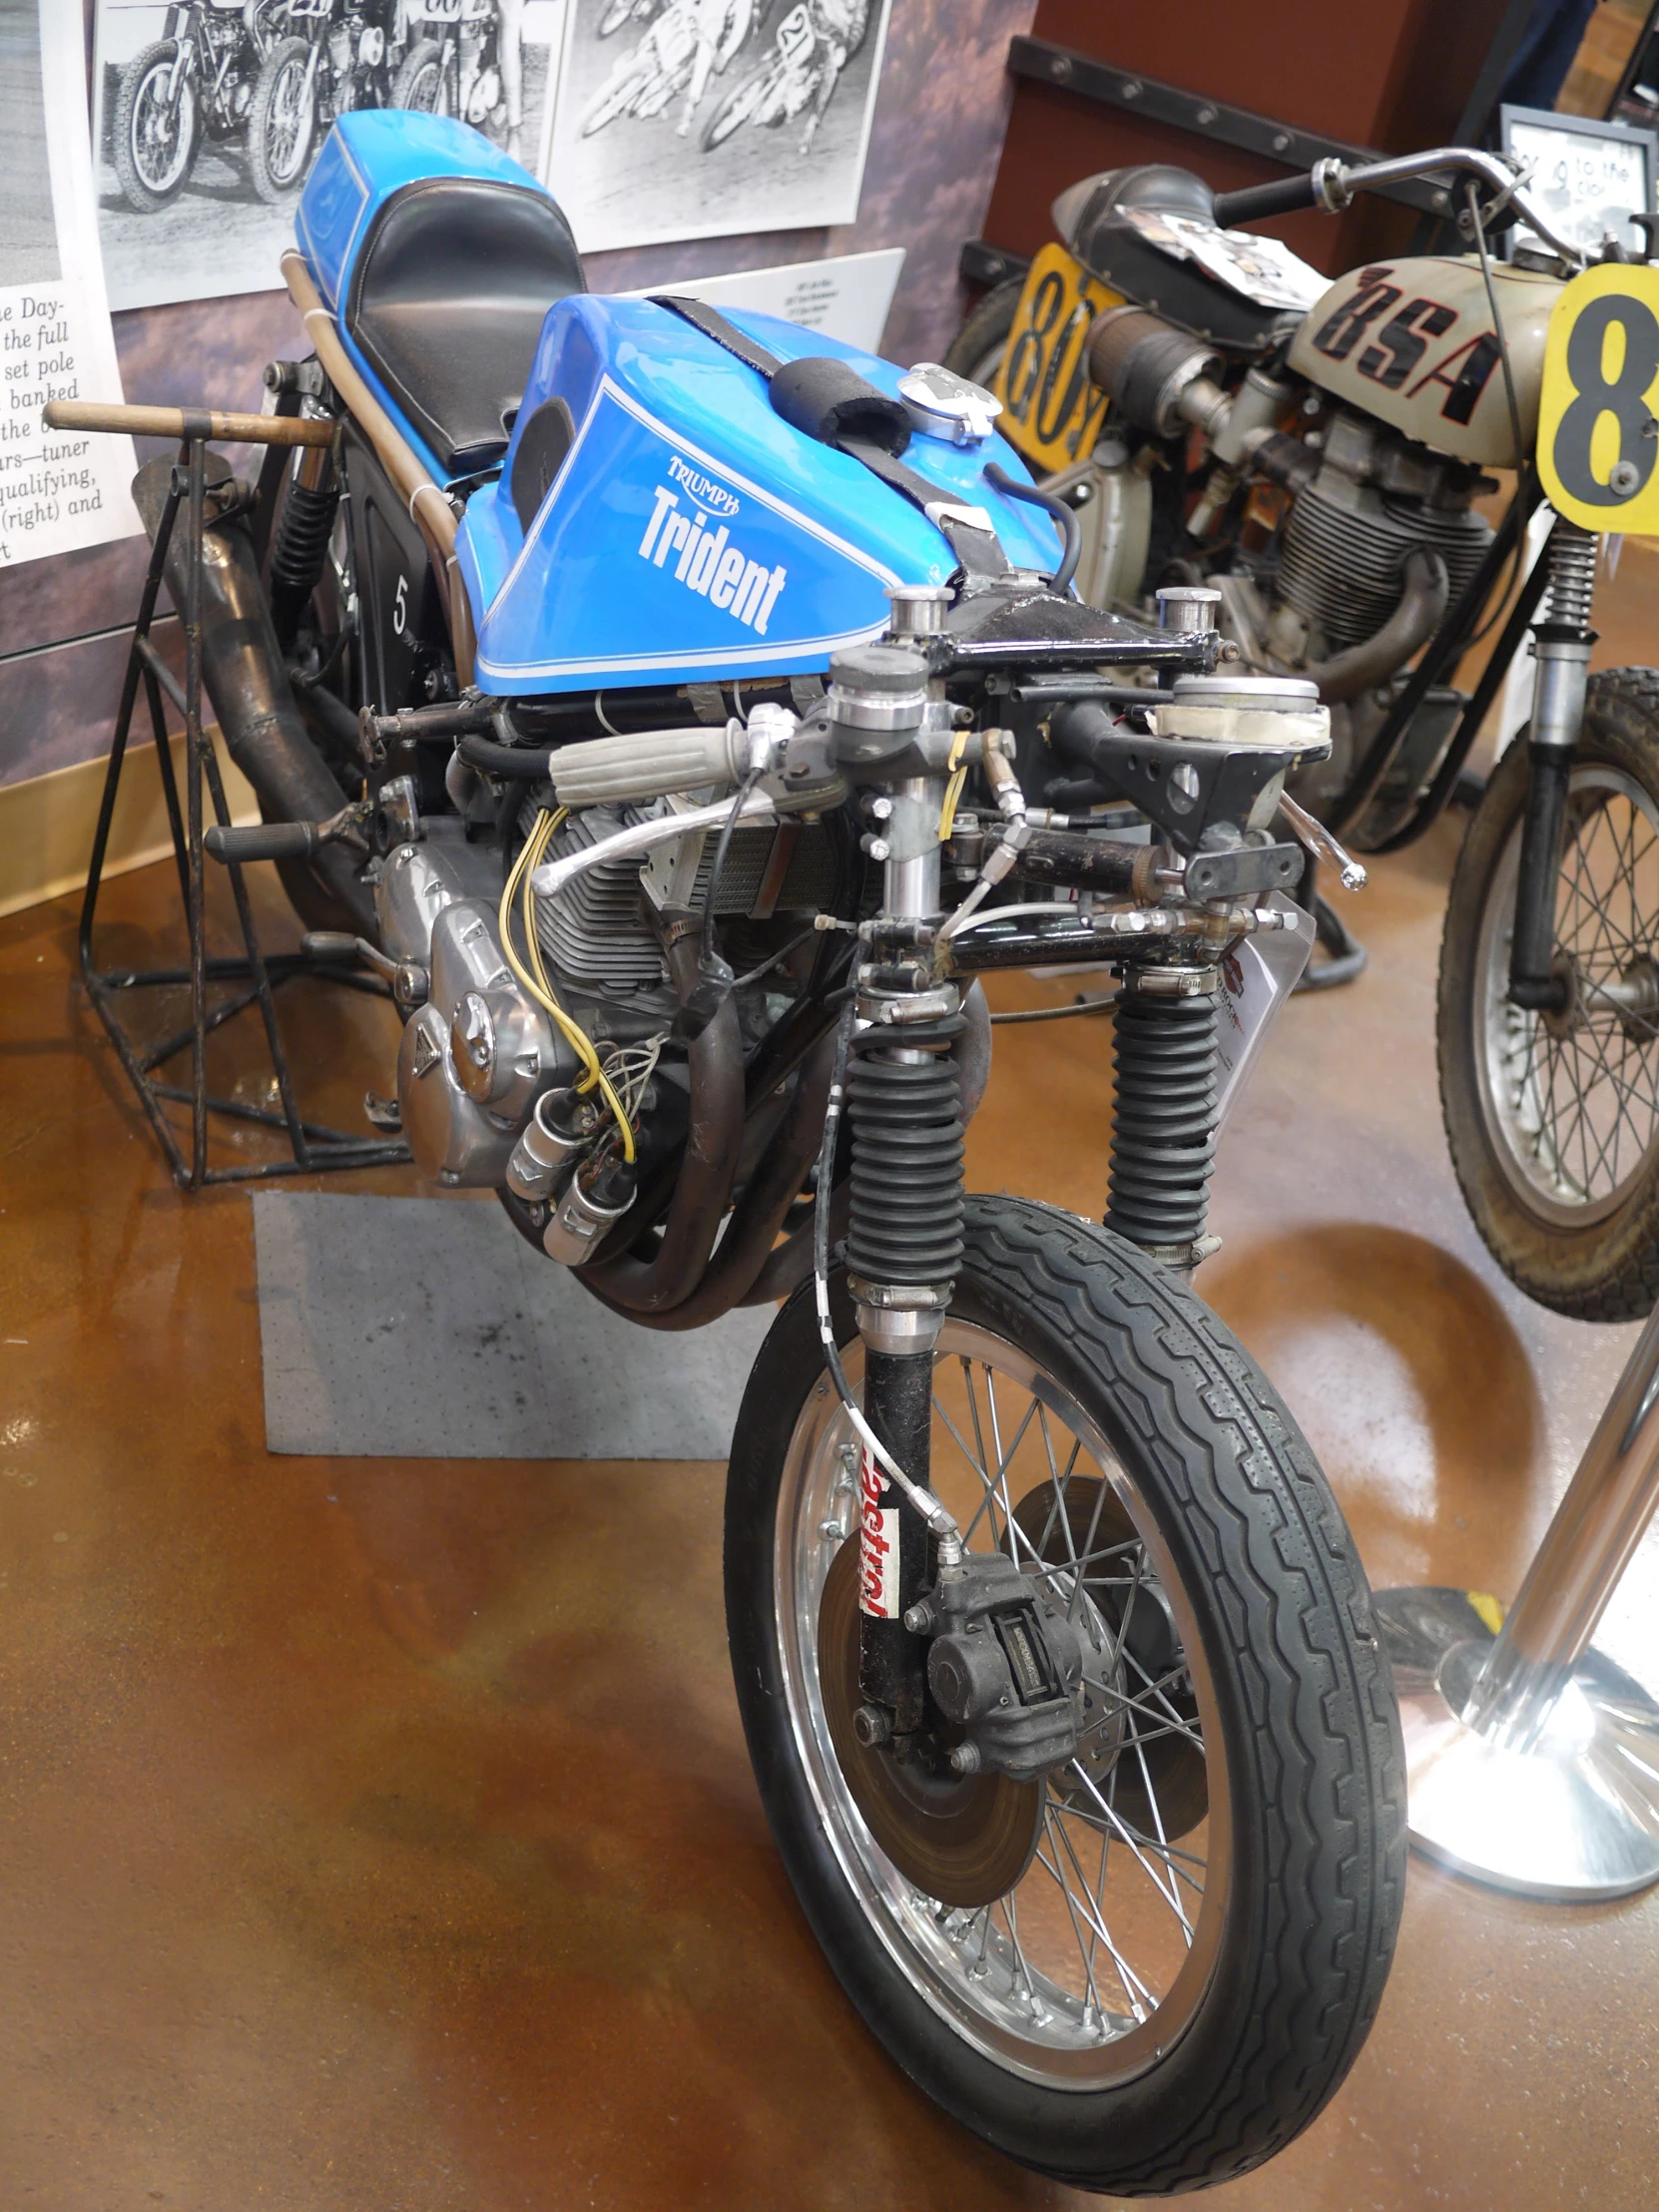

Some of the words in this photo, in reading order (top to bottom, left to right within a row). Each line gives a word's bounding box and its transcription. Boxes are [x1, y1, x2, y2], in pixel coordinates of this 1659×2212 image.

[21, 296, 64, 320] Day-
[4, 328, 32, 351] the
[37, 321, 69, 351] full
[1312, 280, 1504, 426] BSA
[4, 360, 30, 380] set
[38, 351, 75, 380] pole
[10, 378, 80, 409] banked
[1553, 293, 1659, 507] 8
[1, 419, 31, 441] the
[667, 455, 741, 516] TRIUMPH
[2, 497, 60, 532] (right)
[68, 489, 104, 515] and
[638, 485, 788, 637] Trident
[393, 574, 408, 635] 5
